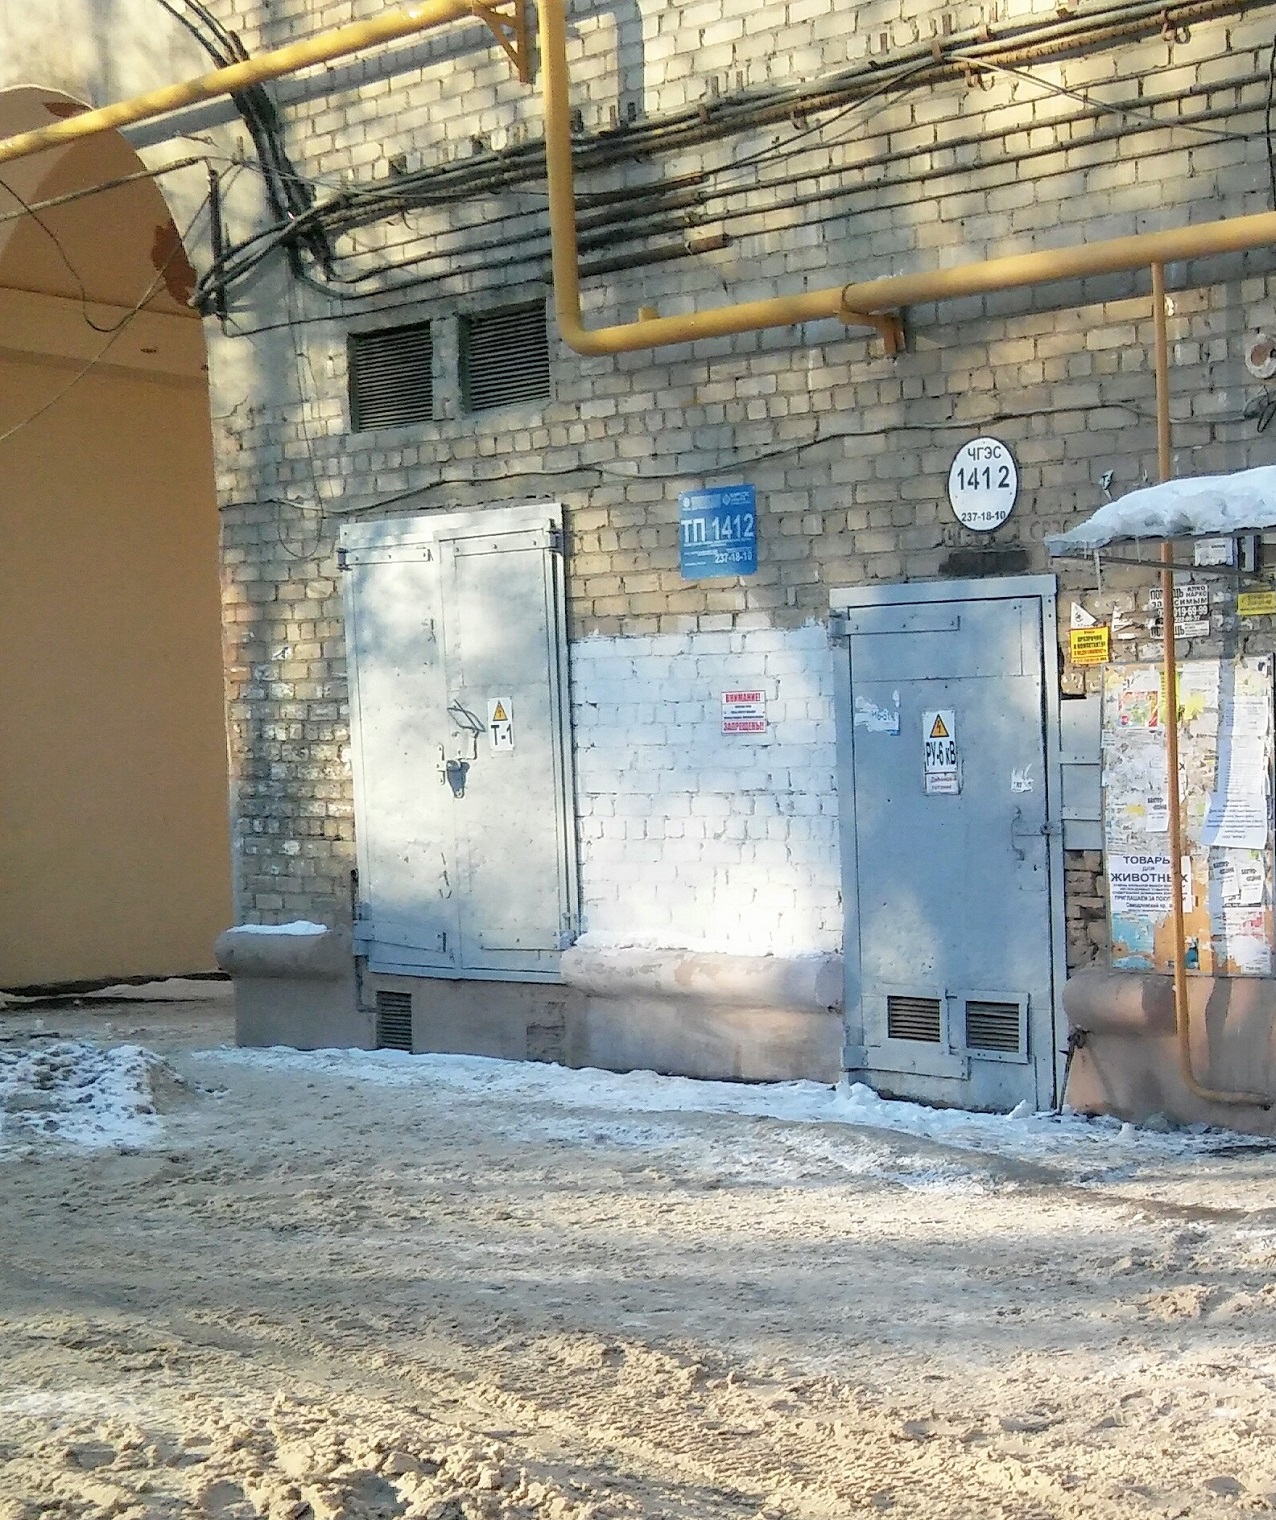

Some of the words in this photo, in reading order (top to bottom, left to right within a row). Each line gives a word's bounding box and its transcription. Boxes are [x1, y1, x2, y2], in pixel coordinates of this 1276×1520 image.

[967, 445, 1002, 461] ЧГЭС
[957, 465, 1010, 491] 1412
[961, 510, 1006, 522] 237-18-10
[680, 518, 706, 543] ТП
[711, 513, 755, 541] 1412
[714, 551, 753, 564] 237-18-10
[726, 693, 761, 703] ВНИМАНИЕ!
[925, 741, 944, 767] РУ-6
[945, 740, 956, 765] кВ
